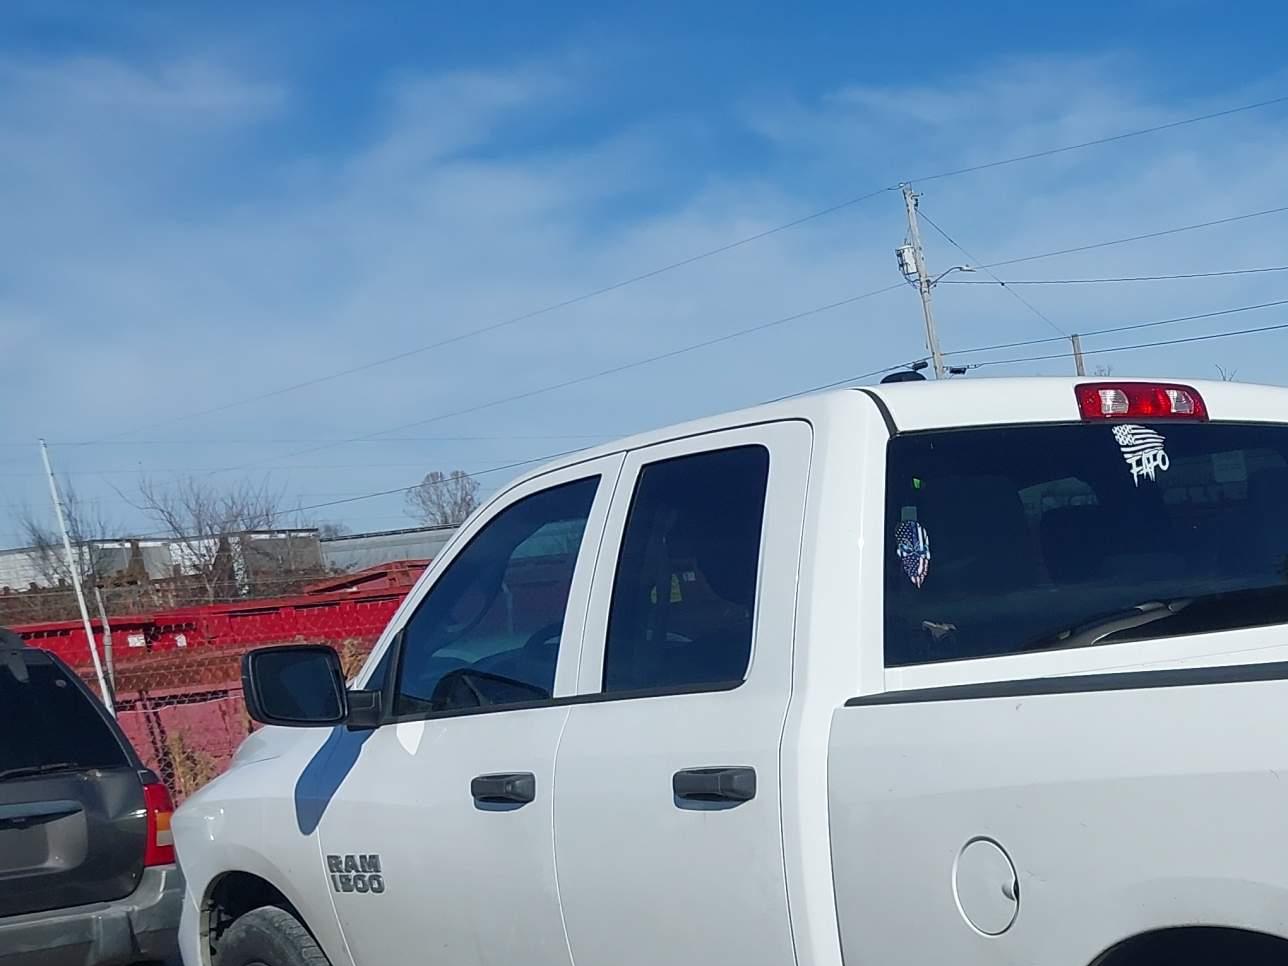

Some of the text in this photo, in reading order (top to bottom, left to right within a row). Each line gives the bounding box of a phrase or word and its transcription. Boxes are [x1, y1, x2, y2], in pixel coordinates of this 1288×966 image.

[1126, 449, 1170, 487] FAFO
[326, 854, 382, 873] RAM
[330, 873, 386, 894] 1500
